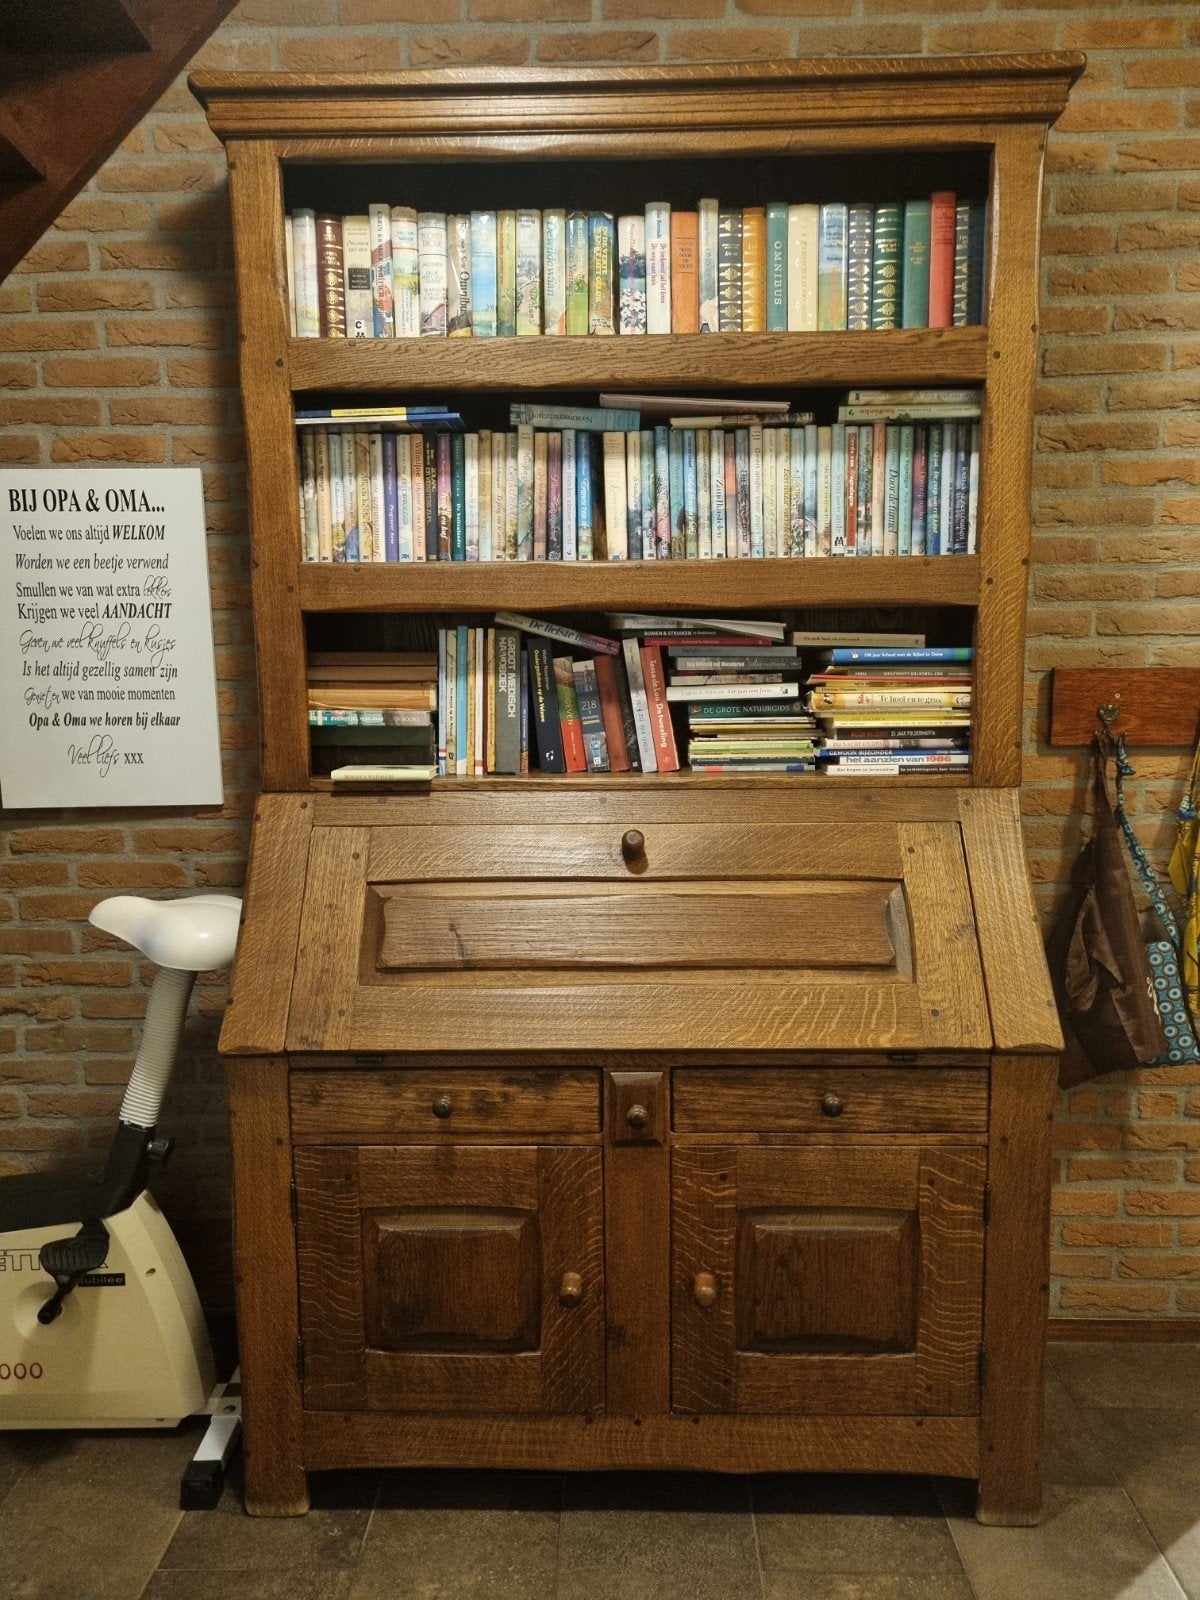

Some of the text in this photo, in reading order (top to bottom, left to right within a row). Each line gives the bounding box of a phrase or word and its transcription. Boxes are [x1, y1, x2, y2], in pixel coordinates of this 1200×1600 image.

[774, 241, 782, 305] OMNIBUS
[459, 271, 470, 317] Omnibus
[413, 441, 422, 478] Wilmijne
[9, 489, 165, 512] BIJ OPA & OMA...
[888, 469, 898, 534] Door de tunnel
[13, 525, 165, 544] Voelen we ons altijd WELKOM
[16, 553, 169, 573] Worden we een beetje verwend
[16, 575, 172, 599] Smullen we van wat extra lekkers
[18, 603, 172, 624] Krijgen we veel AANDACHT
[528, 620, 575, 639] De liefste
[19, 621, 176, 669] Geven we veel knuffels en kusjes
[23, 661, 178, 682] Is het altijd gezellig samen zijn
[649, 660, 657, 679] Tessa
[62, 690, 75, 701] we
[78, 690, 94, 700] van
[97, 686, 125, 701] mooie
[128, 689, 175, 701] momenten
[652, 679, 659, 688] de
[508, 673, 516, 717] MEDISCH
[582, 700, 597, 711] 218
[29, 713, 180, 730] Opa & Oma we horen bij elkaar
[656, 703, 667, 748] De tweeling
[67, 735, 144, 778] Veel liefs xxx
